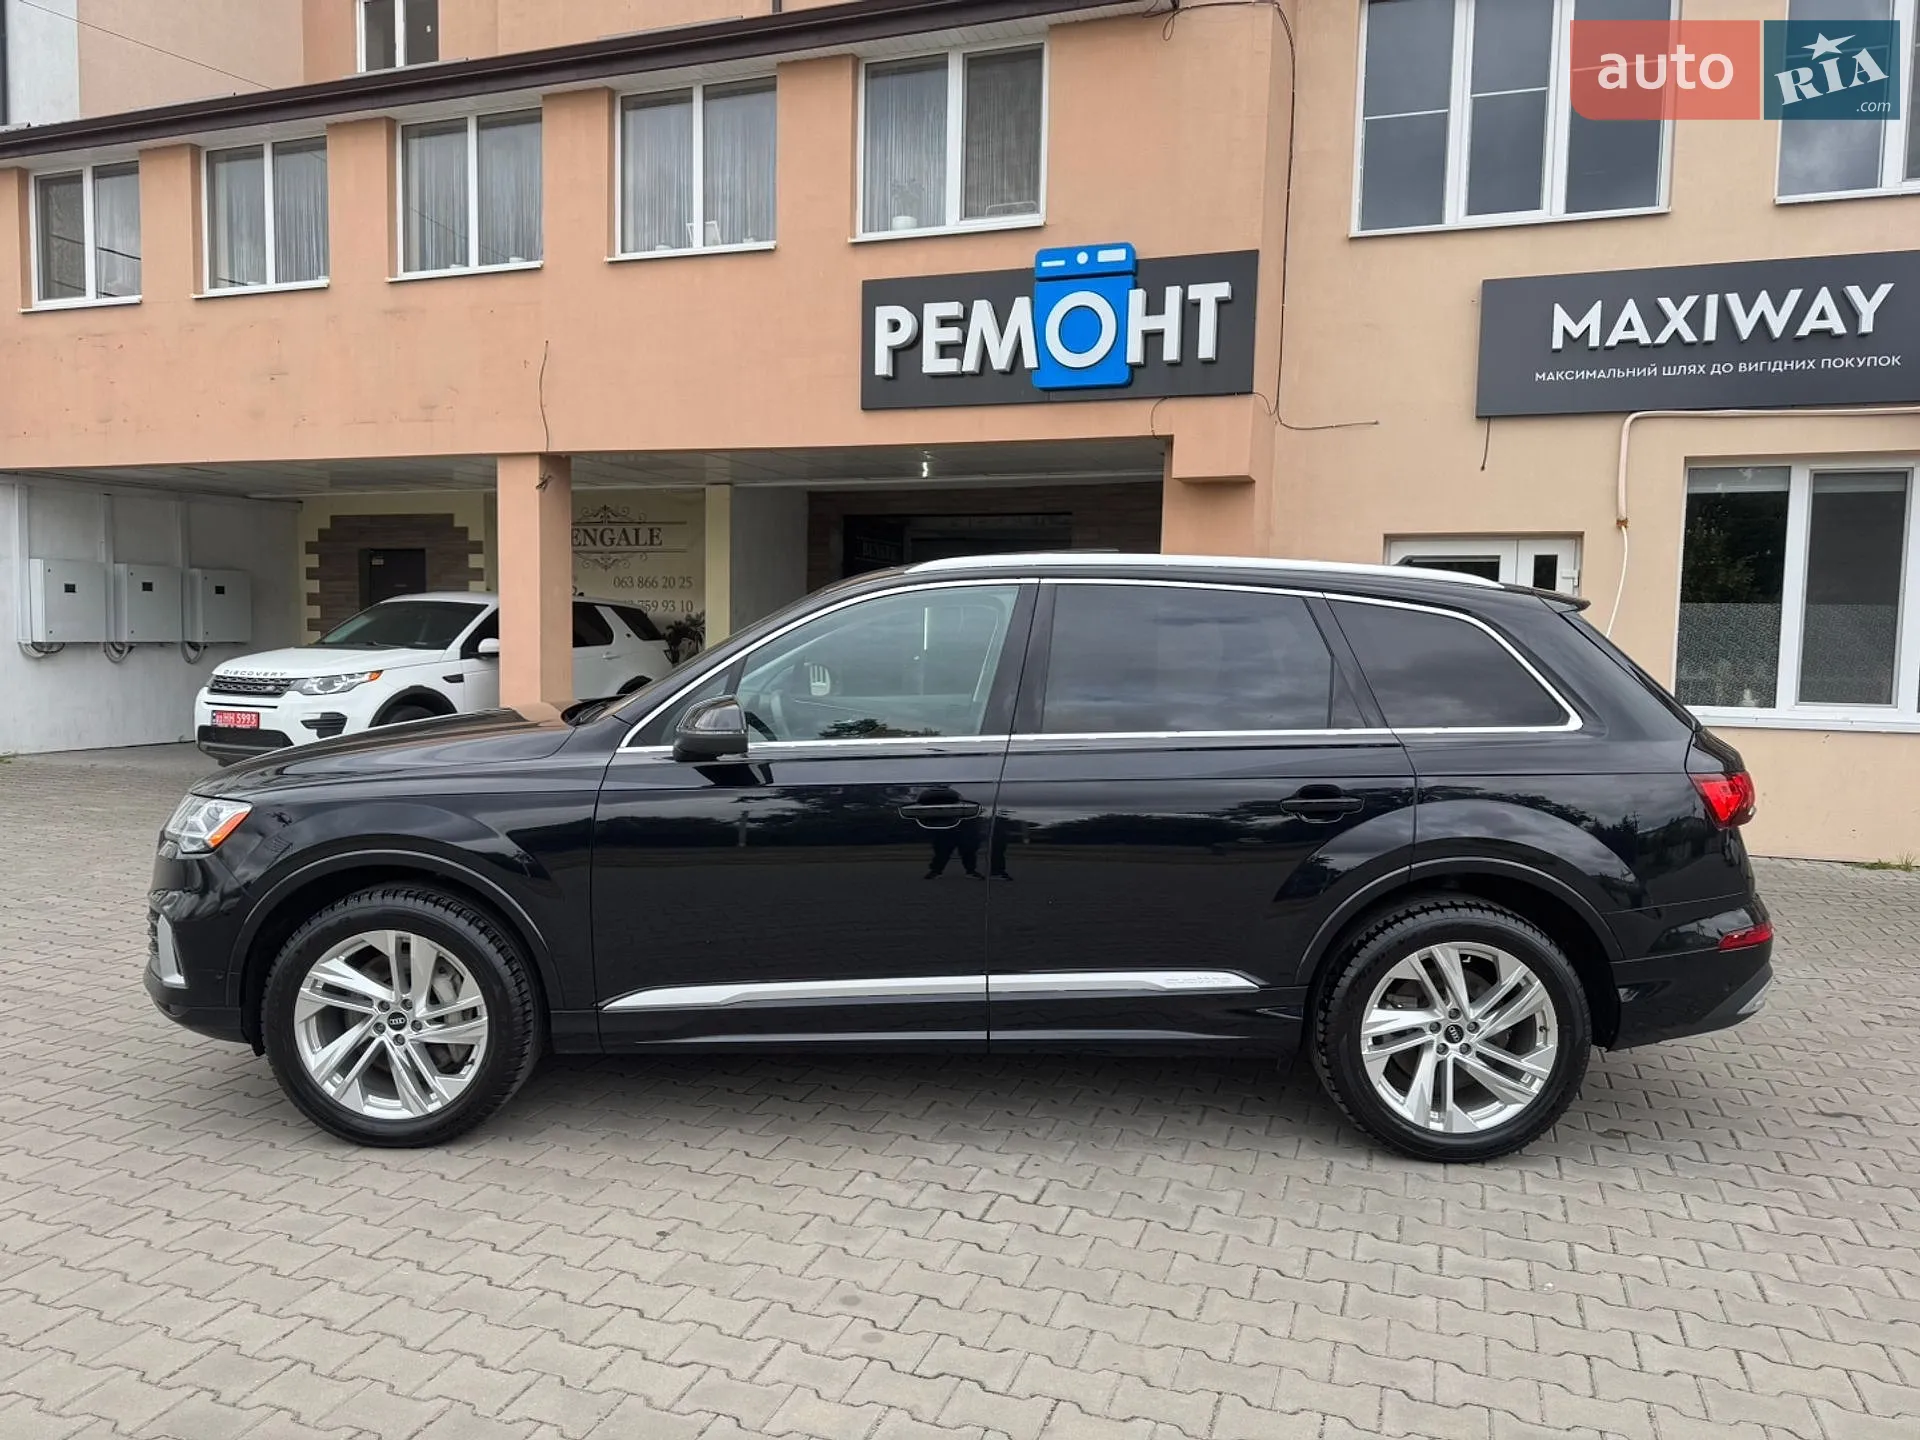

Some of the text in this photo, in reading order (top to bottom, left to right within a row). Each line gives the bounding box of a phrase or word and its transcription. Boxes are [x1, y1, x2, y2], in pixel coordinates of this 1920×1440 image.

[1551, 282, 1896, 353] MAXIWAY
[874, 281, 1233, 379] РЕМОНТ
[1534, 354, 1902, 382] МАКСИМАЛЬНИЙ ШЛЯХ ДО ВИГІДНИХ ПОКУПОК
[613, 575, 694, 589] 063 866 20 25
[661, 599, 676, 613] 93
[680, 599, 694, 613] 10
[223, 669, 288, 677] DISCOVERY
